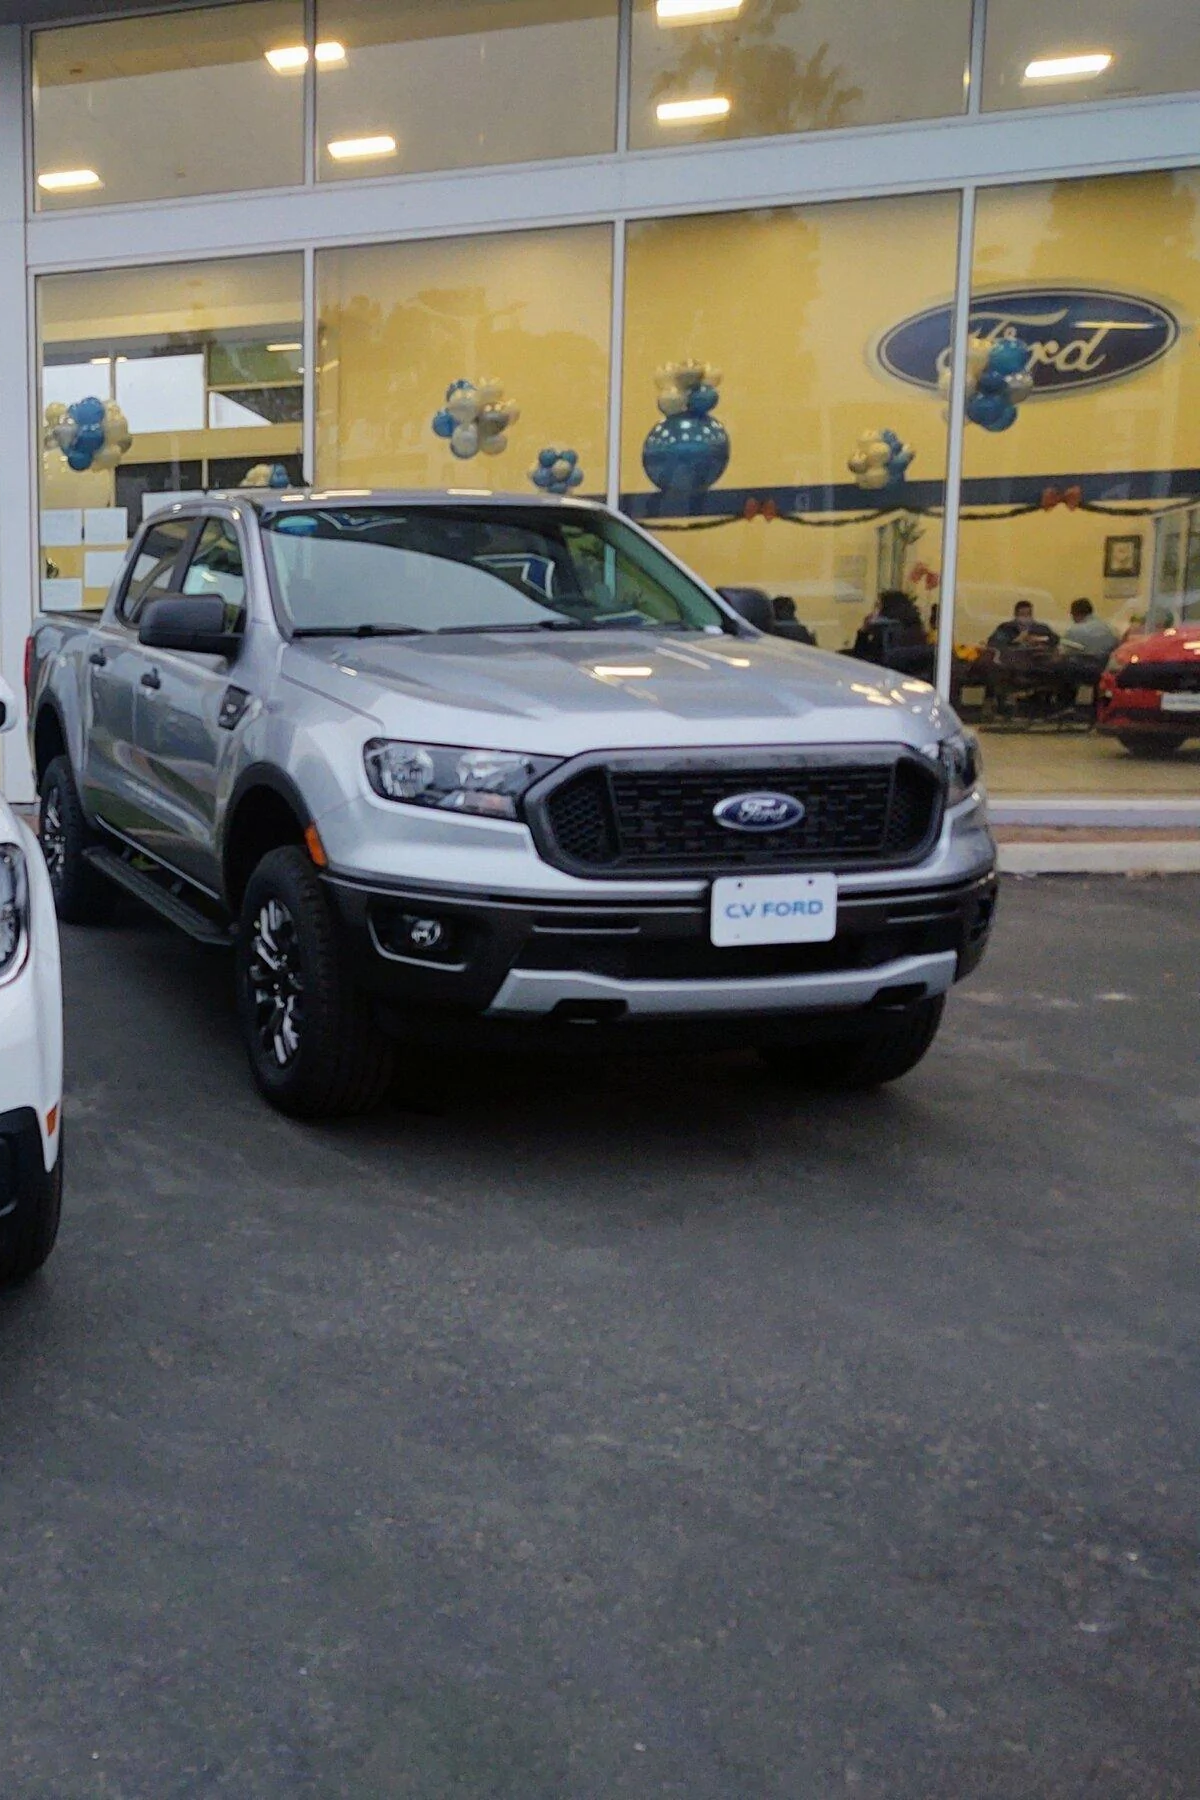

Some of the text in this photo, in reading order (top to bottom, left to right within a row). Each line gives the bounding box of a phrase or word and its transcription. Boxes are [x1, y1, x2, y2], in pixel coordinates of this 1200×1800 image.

[936, 308, 1111, 377] Frd
[738, 799, 788, 823] Ford
[725, 899, 824, 919] CV FORD
